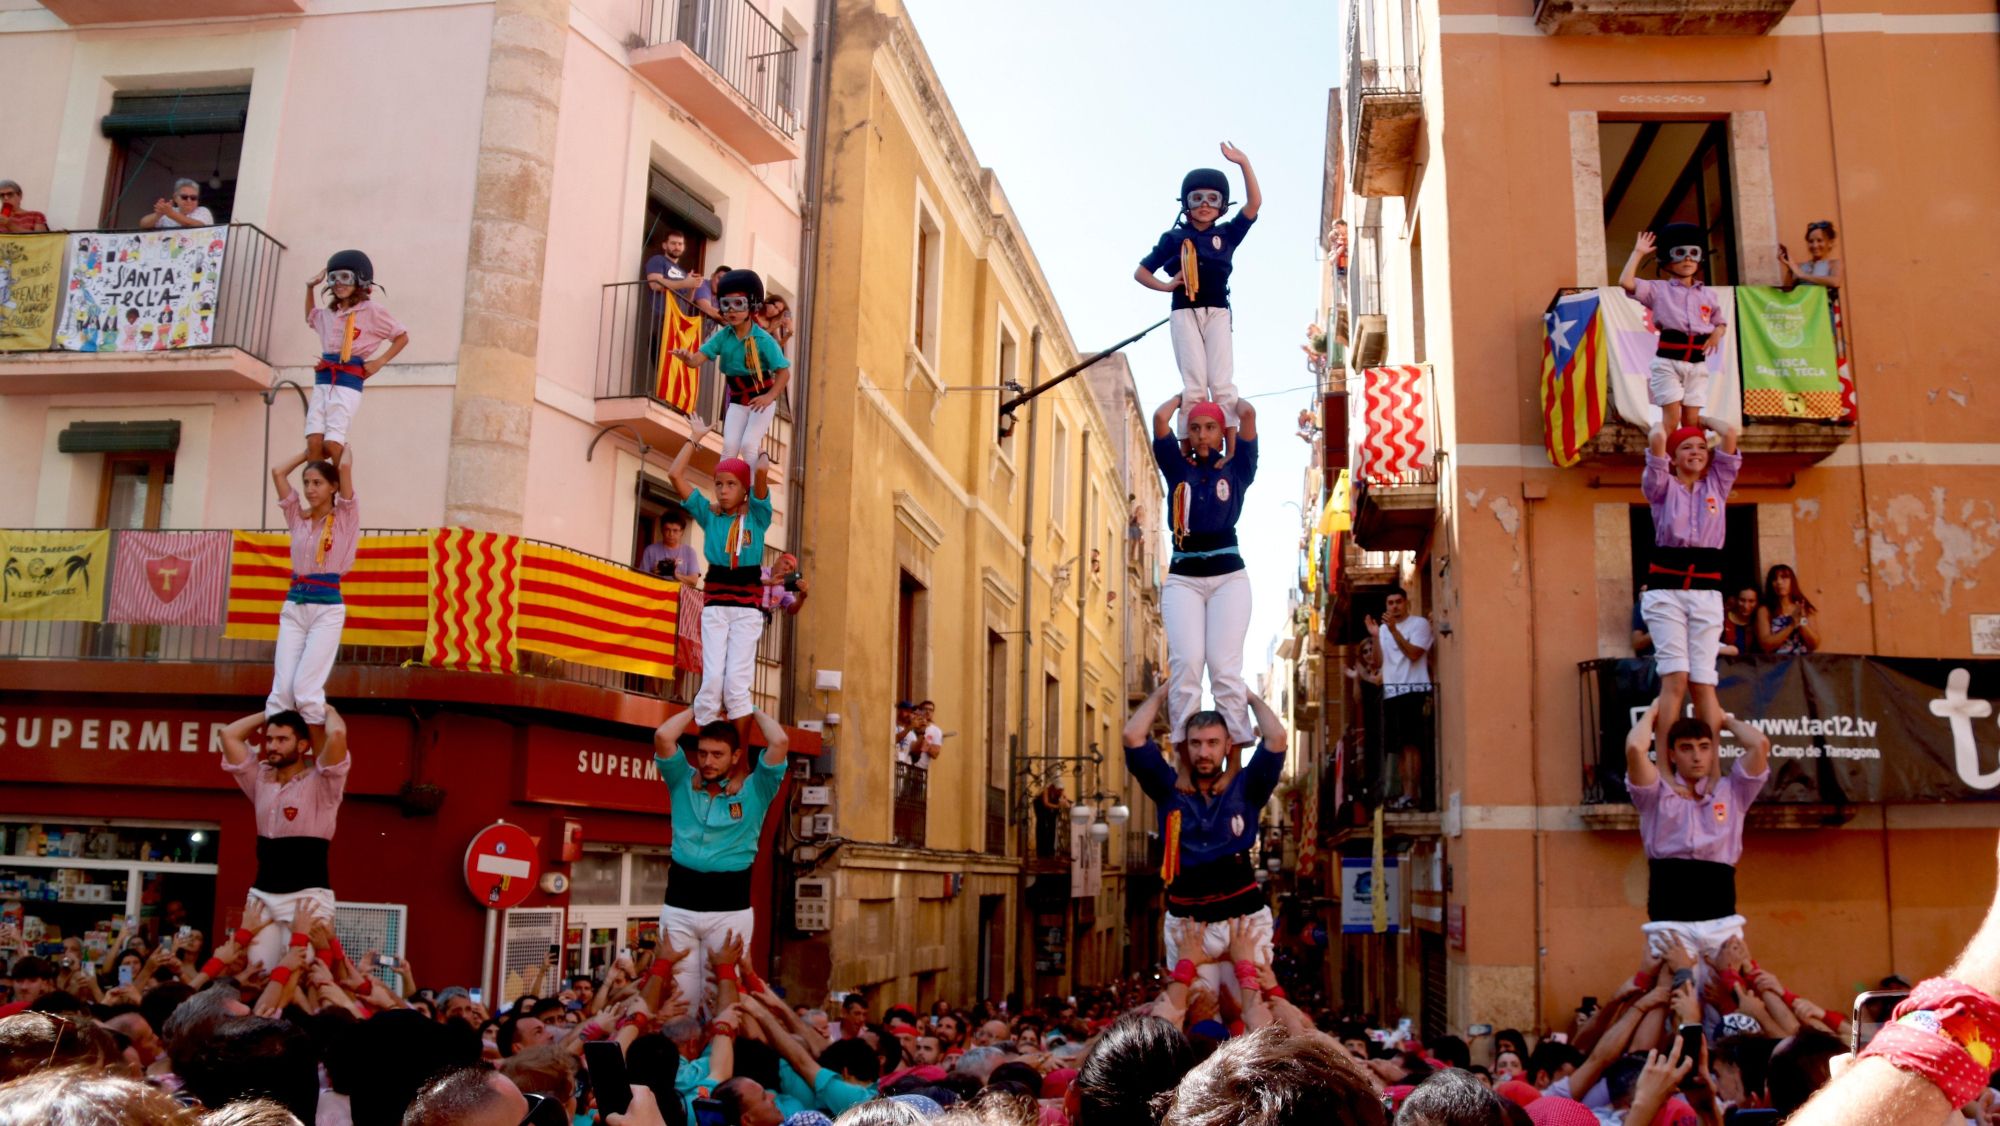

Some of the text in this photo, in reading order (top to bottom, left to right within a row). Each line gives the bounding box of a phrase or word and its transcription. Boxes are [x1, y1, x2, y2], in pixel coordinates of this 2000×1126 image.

[112, 265, 174, 288] SANTA
[1773, 358, 1808, 368] VISCA
[1771, 744, 1804, 759] Camp
[1805, 745, 1822, 757] de
[1823, 745, 1880, 760] Tarragona
[577, 750, 665, 782] SUPERM
